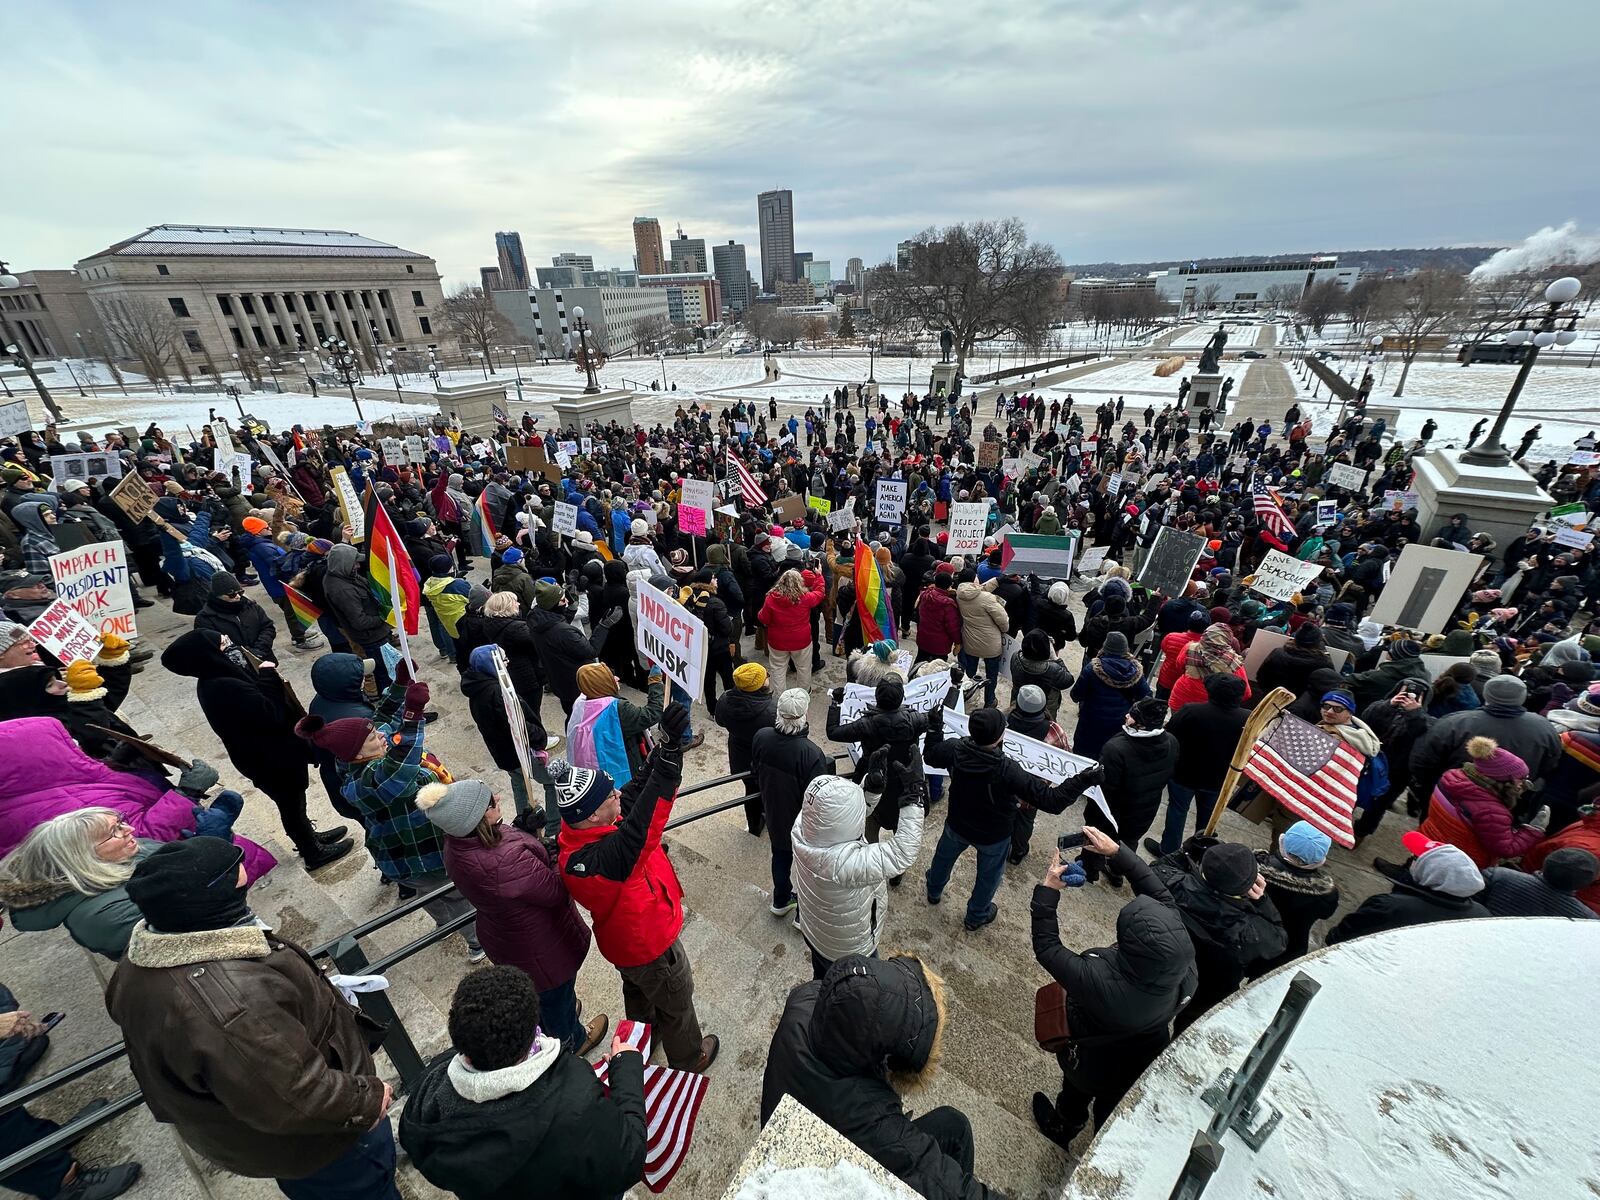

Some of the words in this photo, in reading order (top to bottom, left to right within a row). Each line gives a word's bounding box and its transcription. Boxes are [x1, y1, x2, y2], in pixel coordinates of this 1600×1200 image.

[881, 484, 898, 493] MAKE
[880, 494, 904, 503] AMERICA
[879, 503, 895, 511] KIND
[878, 511, 898, 519] AGAIN
[952, 529, 985, 538] PROJECT
[955, 540, 979, 549] 2025
[53, 548, 116, 581] IMPEACH
[1266, 555, 1291, 564] SAVE
[56, 566, 126, 600] PRESIDENT
[1252, 575, 1277, 587] JAIL
[71, 590, 109, 617] MUSK
[29, 620, 52, 643] NO
[43, 600, 71, 627] MUSK
[640, 592, 694, 649] INDICT
[58, 648, 72, 665] NO
[644, 628, 688, 684] MUSK
